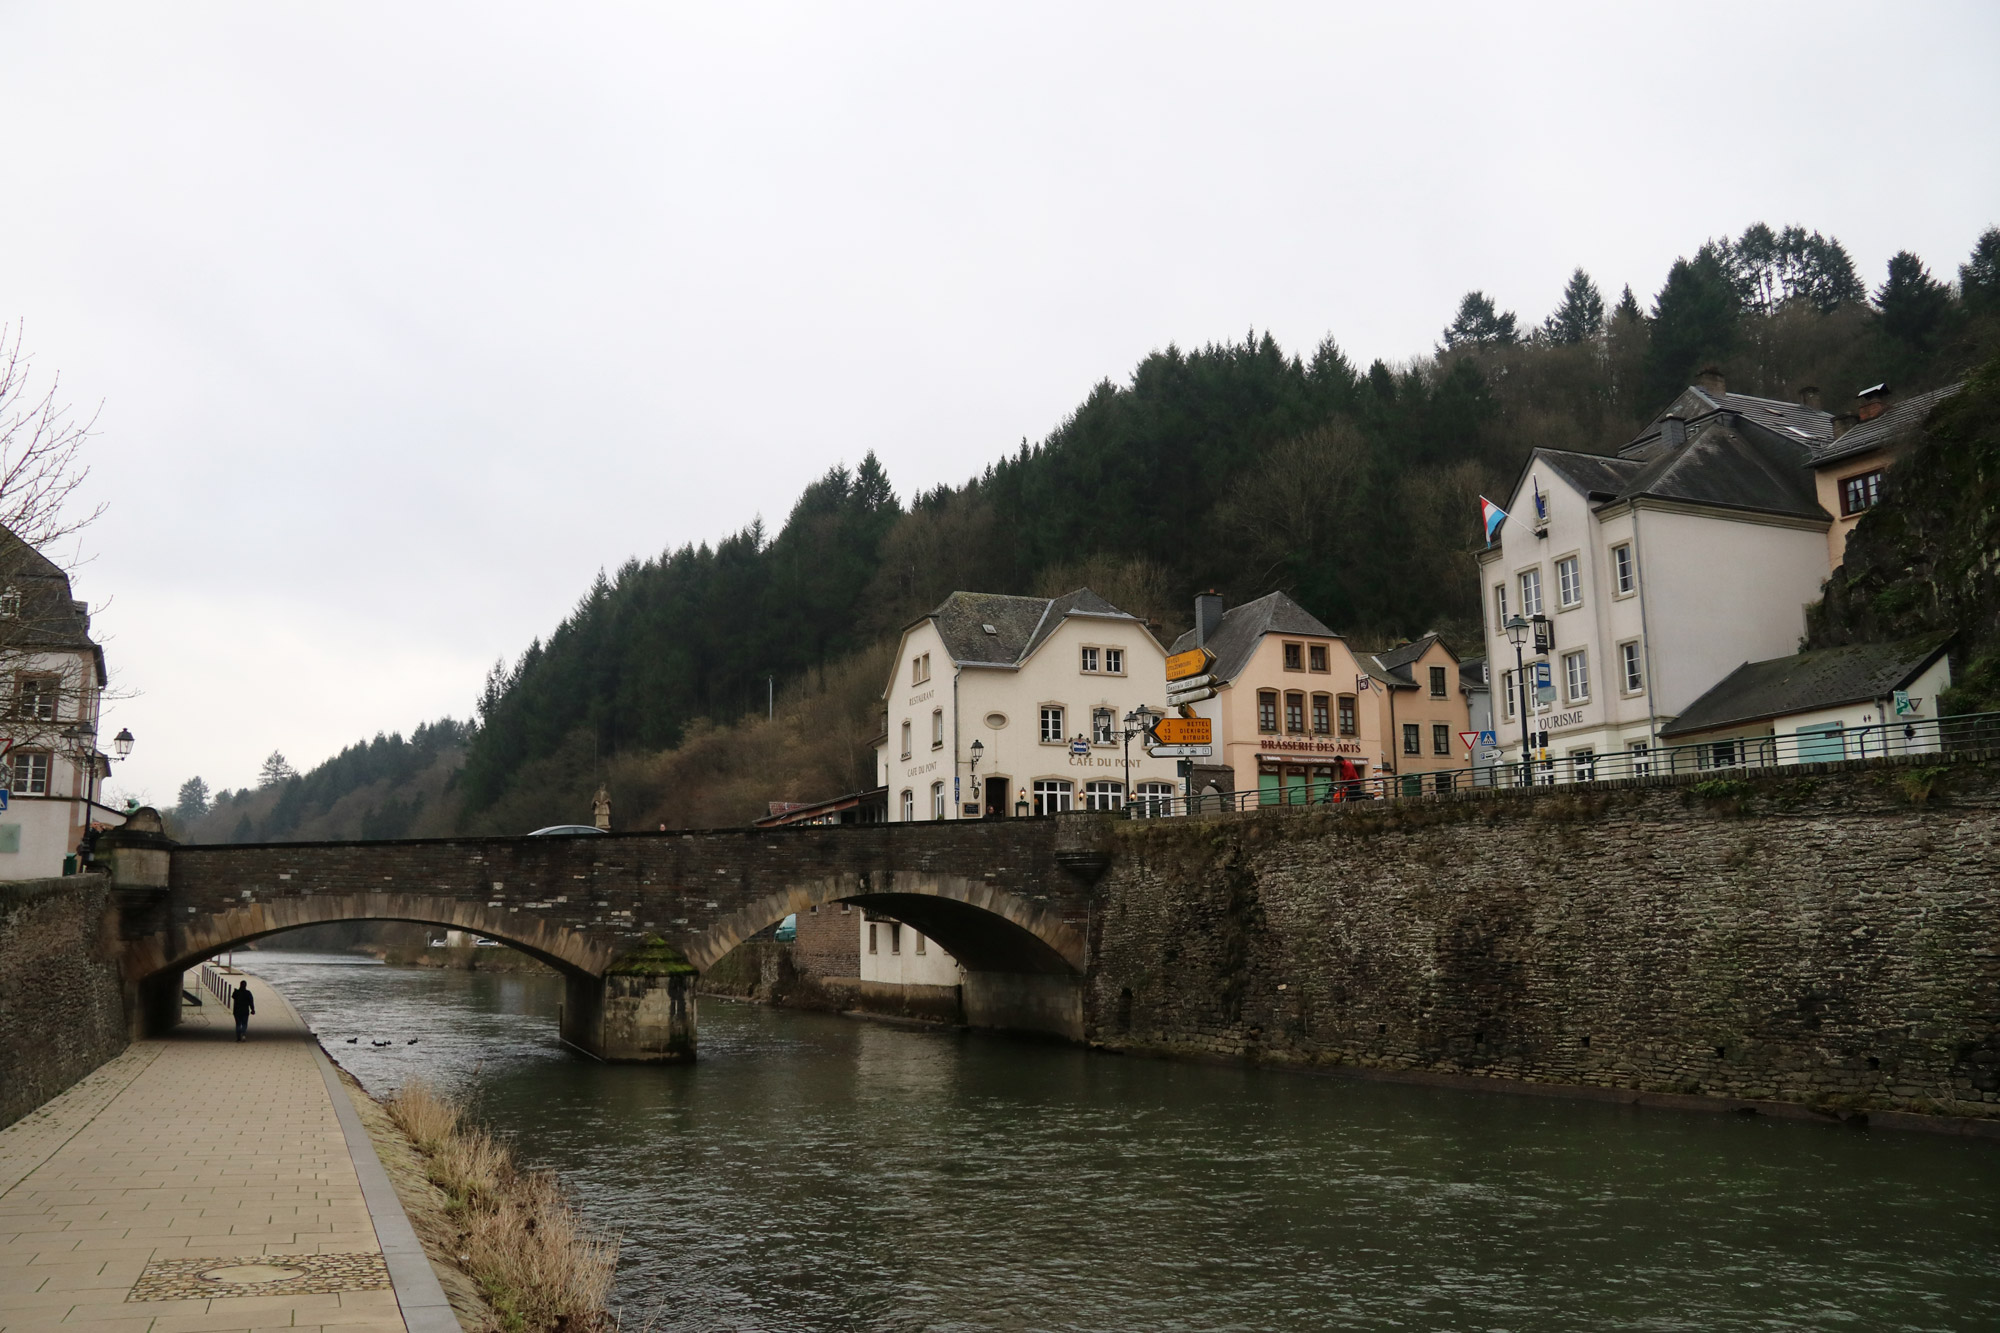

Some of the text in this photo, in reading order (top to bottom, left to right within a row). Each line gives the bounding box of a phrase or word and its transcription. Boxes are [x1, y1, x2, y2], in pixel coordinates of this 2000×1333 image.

[909, 690, 934, 706] RESTAURANT
[1261, 740, 1361, 753] BRASSERIE DES ARTS
[918, 765, 924, 774] DU
[926, 761, 937, 772] PONT
[1069, 758, 1142, 767] CAFE DU PONT
